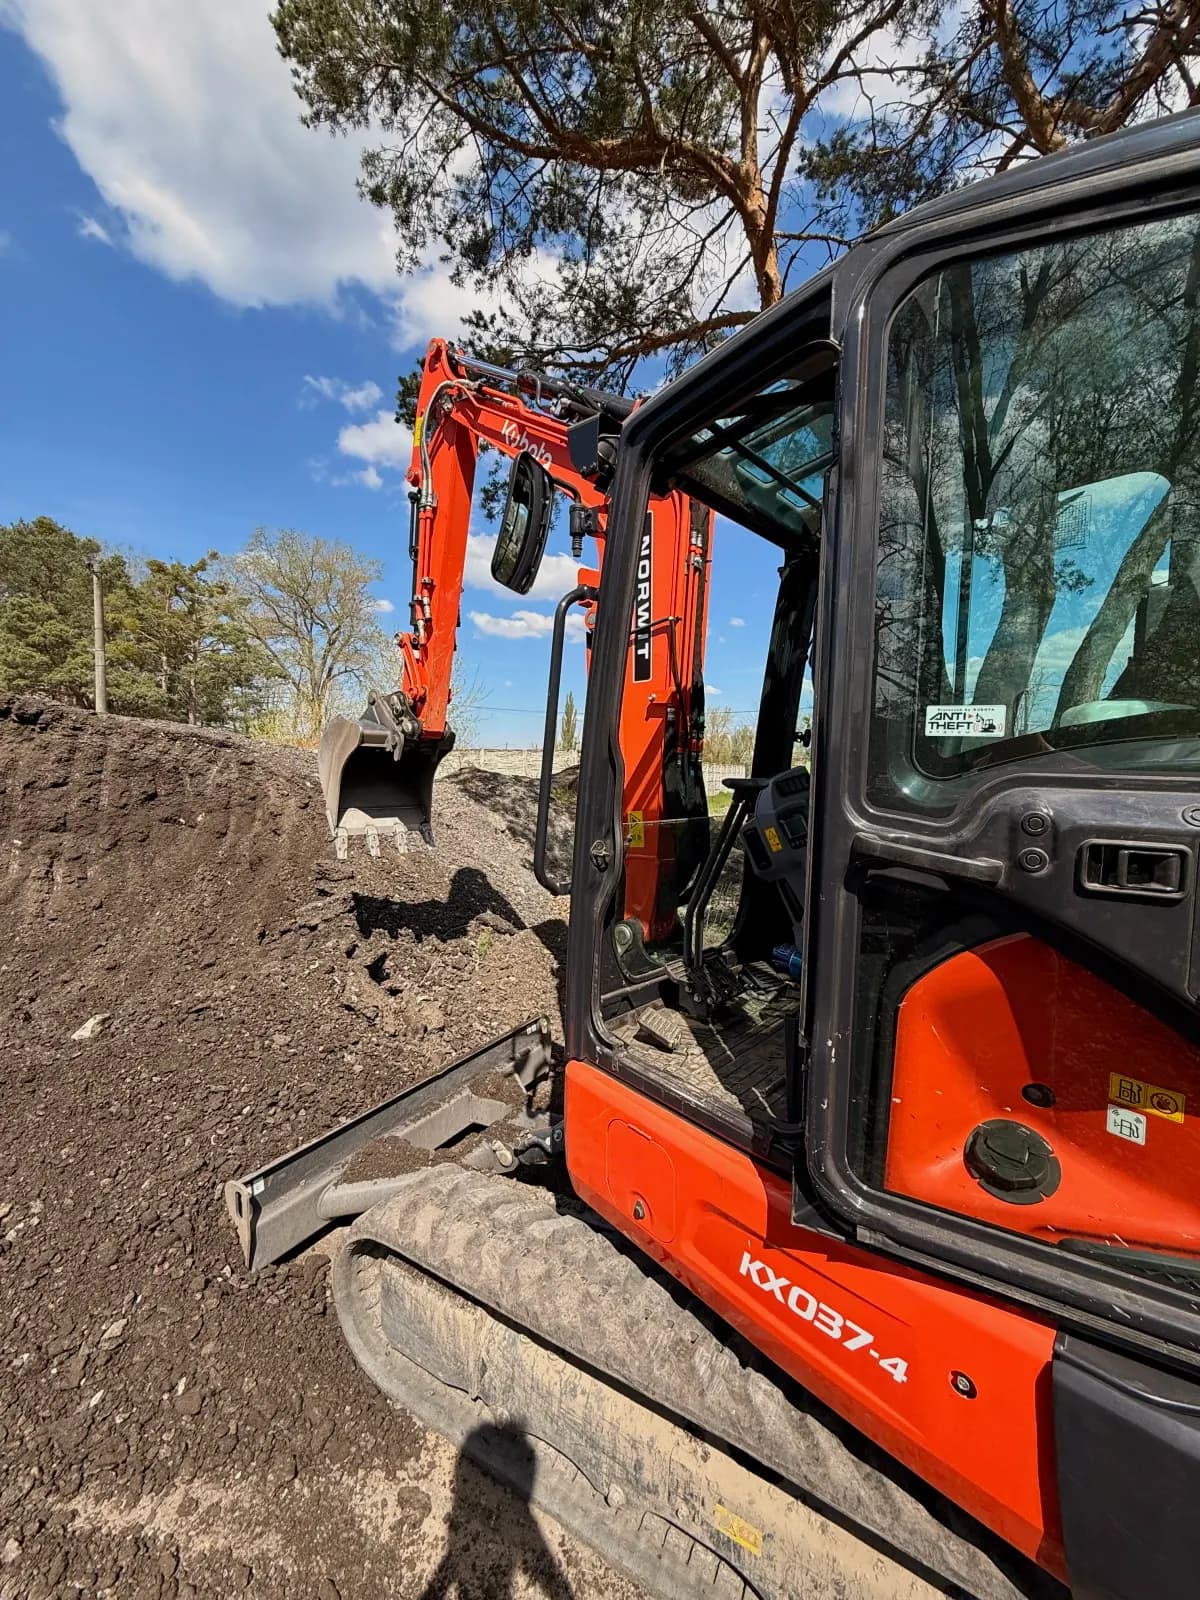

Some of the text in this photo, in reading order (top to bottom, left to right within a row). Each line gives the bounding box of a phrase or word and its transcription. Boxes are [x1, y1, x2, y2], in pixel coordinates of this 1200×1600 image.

[501, 419, 552, 470] Kubota
[637, 535, 650, 660] NORWIT
[928, 721, 973, 730] THEFT
[929, 712, 967, 720] ANTI
[738, 1251, 908, 1383] KX037-4
